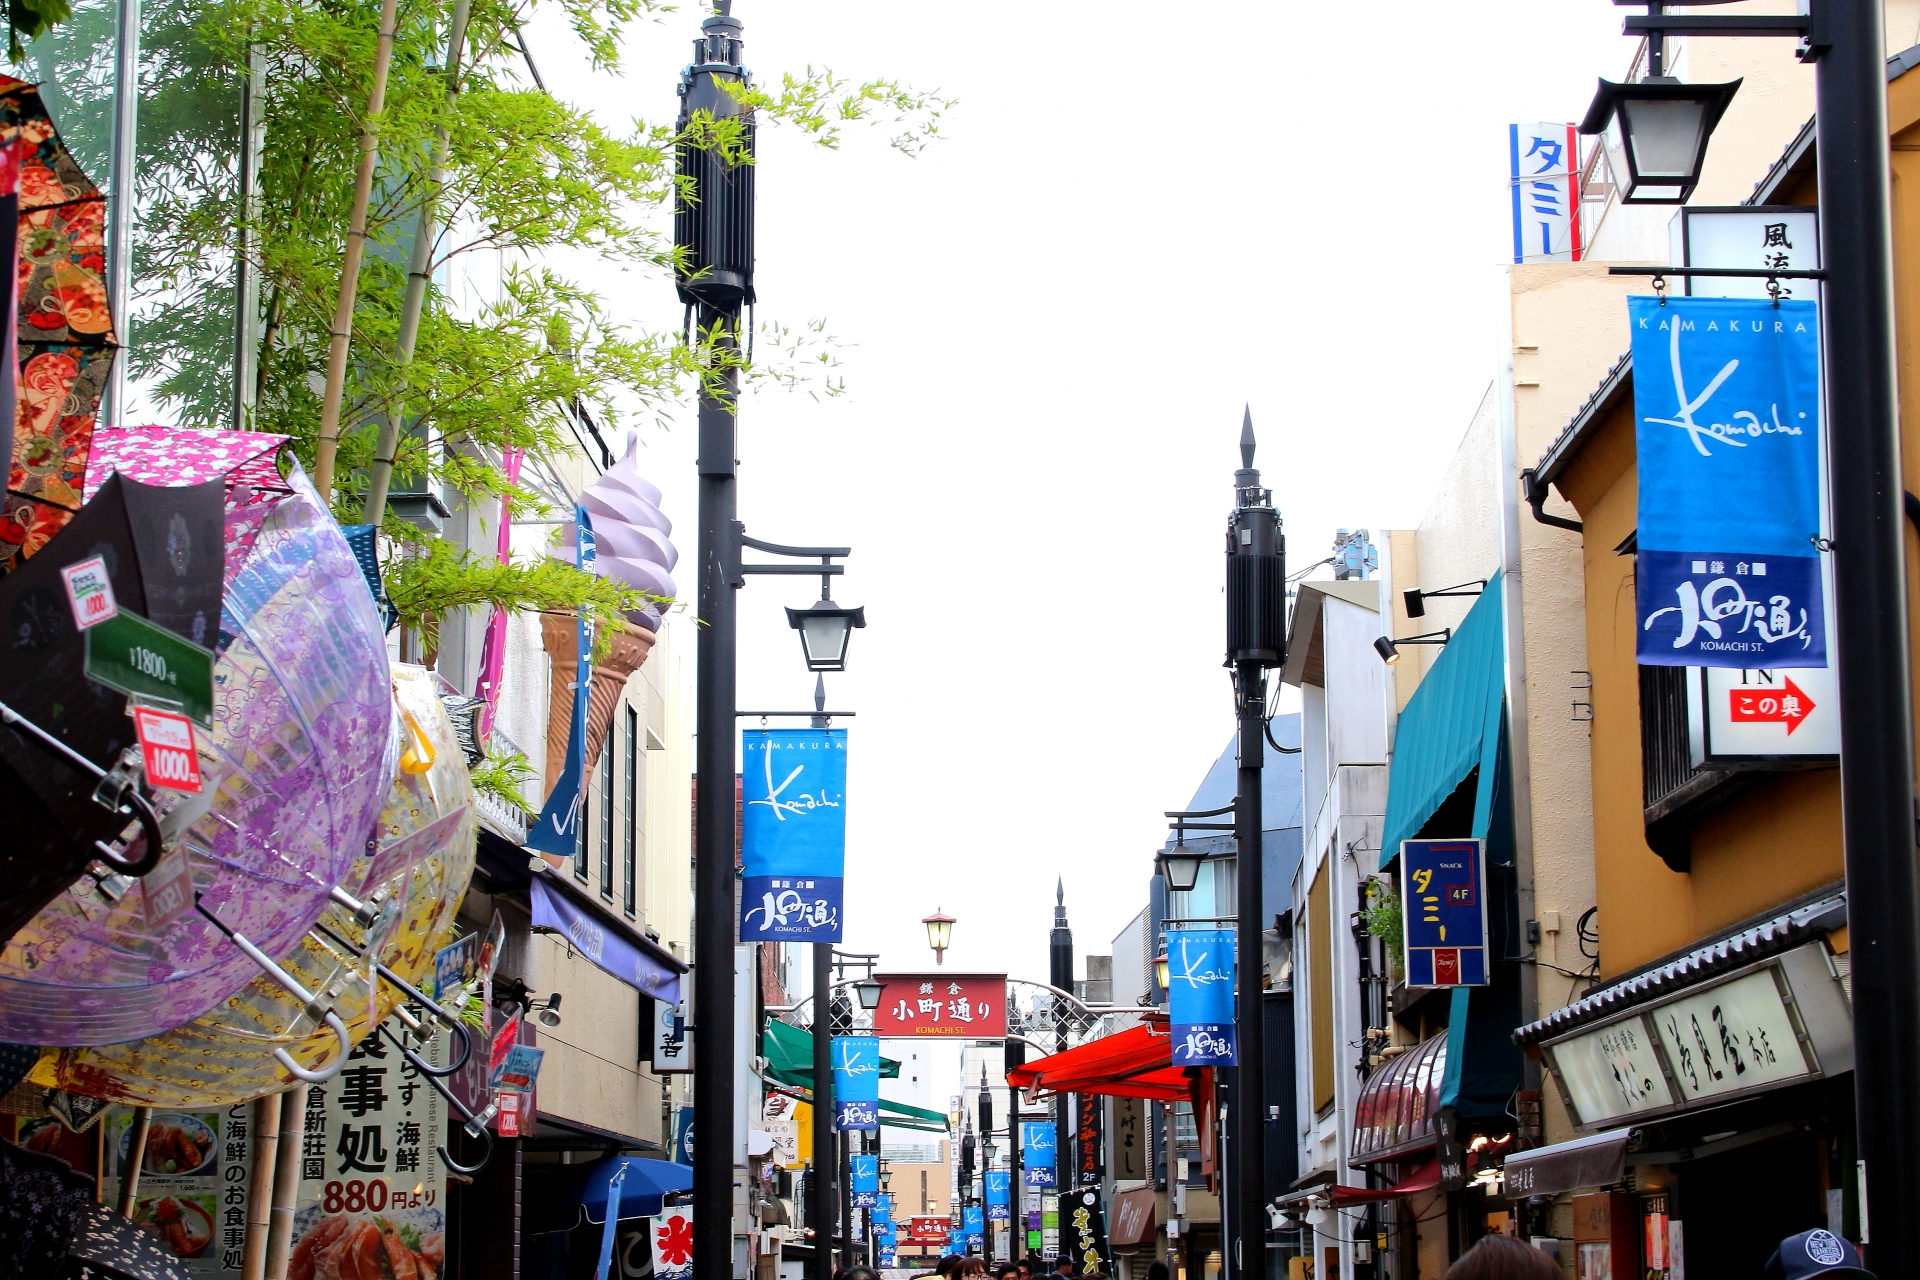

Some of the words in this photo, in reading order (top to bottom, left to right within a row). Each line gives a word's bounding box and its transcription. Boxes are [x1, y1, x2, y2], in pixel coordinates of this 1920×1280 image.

[1524, 136, 1562, 255] タミー
[1639, 317, 1806, 333] KAMAKURA
[1643, 314, 1806, 457] Komachi
[1710, 561, 1750, 575] 鎌倉
[1644, 577, 1811, 650] 小町通り
[1700, 641, 1749, 651] KOMACHI
[1751, 642, 1764, 652] ST.
[1740, 694, 1802, 717] この奥
[749, 742, 842, 750] KAMAKURA
[748, 739, 841, 821] Komachi
[782, 880, 805, 889] 鎌倉
[1452, 889, 1469, 899] 4F
[744, 889, 837, 932] 小町通り
[1412, 868, 1446, 942] タミー
[1172, 936, 1230, 988] Komachi
[919, 982, 962, 995] 鎌倉
[892, 997, 990, 1022] 小町通り
[915, 1026, 953, 1034] KOMACHI
[955, 1026, 966, 1034] ST.
[302, 1081, 328, 1180] 倉新荘園
[427, 1124, 438, 1184] Restaurant
[1082, 1172, 1096, 1181] 2F
[657, 1215, 693, 1265] 氷
